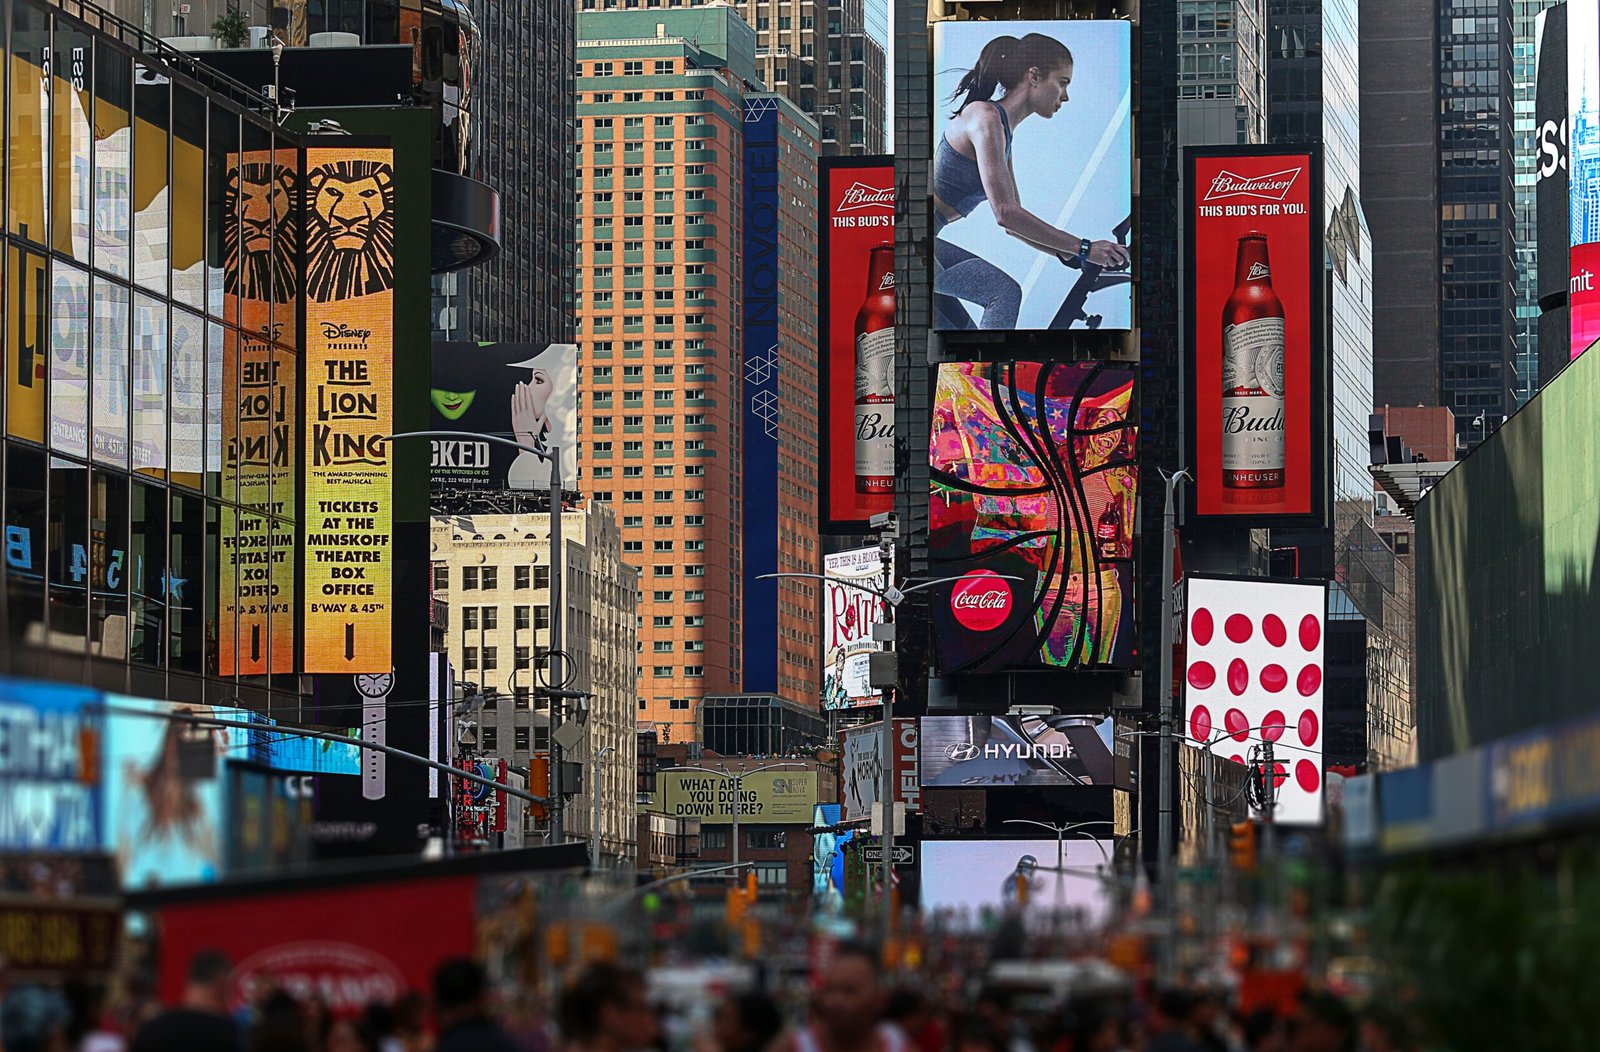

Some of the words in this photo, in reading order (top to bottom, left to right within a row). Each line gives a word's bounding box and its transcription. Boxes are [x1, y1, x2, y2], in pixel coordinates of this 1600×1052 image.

[1212, 177, 1291, 193] Budweiser
[1199, 206, 1223, 217] THIS
[1225, 205, 1257, 216] BUD'S
[1259, 204, 1280, 215] FOR
[1282, 203, 1307, 214] YOU.
[749, 123, 777, 326] NOVOTEL
[832, 217, 855, 228] THIS
[858, 216, 889, 227] BUD'S
[320, 322, 371, 343] Disney
[324, 360, 368, 380] THE
[318, 385, 377, 420] LION
[94, 437, 105, 448] ON
[313, 424, 386, 467] KING
[1230, 473, 1279, 481] NHEUSER
[318, 501, 379, 513] TICKETS
[322, 518, 342, 529] AT
[346, 518, 375, 529] THE
[308, 534, 389, 546] MINSKOFF
[315, 551, 381, 563] THEATRE
[331, 567, 366, 579] BOX
[322, 584, 375, 596] OFFICE
[311, 604, 348, 613] B'WAY
[350, 604, 359, 613] &
[361, 604, 385, 613] 45TH
[857, 758, 883, 780] MORMON
[901, 722, 920, 810] HELLO!
[680, 779, 716, 791] WHAT
[718, 779, 743, 790] ARE
[689, 791, 714, 802] YOU
[676, 803, 714, 815] DOWN
[718, 803, 764, 815] THERE?
